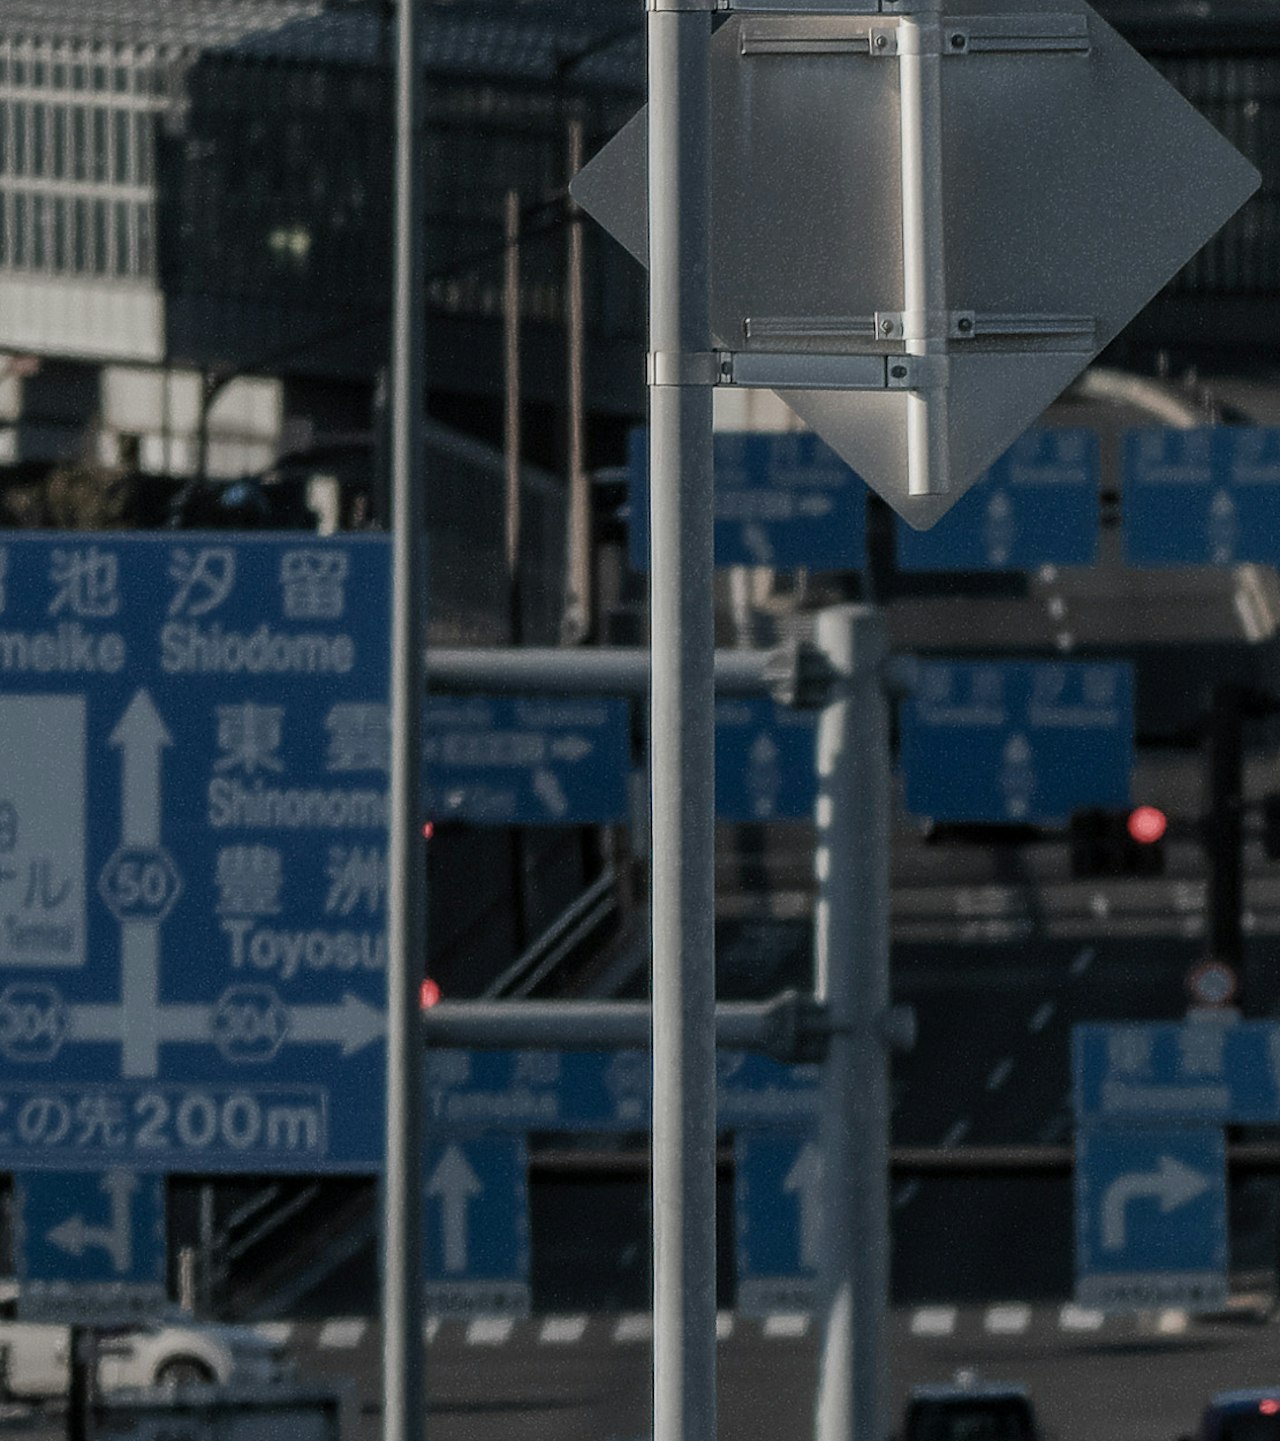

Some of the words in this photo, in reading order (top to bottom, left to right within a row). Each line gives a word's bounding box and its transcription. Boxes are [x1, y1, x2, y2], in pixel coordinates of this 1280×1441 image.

[166, 544, 349, 619] 汐留
[160, 622, 355, 674] Shiodome
[208, 777, 390, 828] Shinonom
[118, 862, 166, 905] 50
[220, 918, 389, 980] Toyosu
